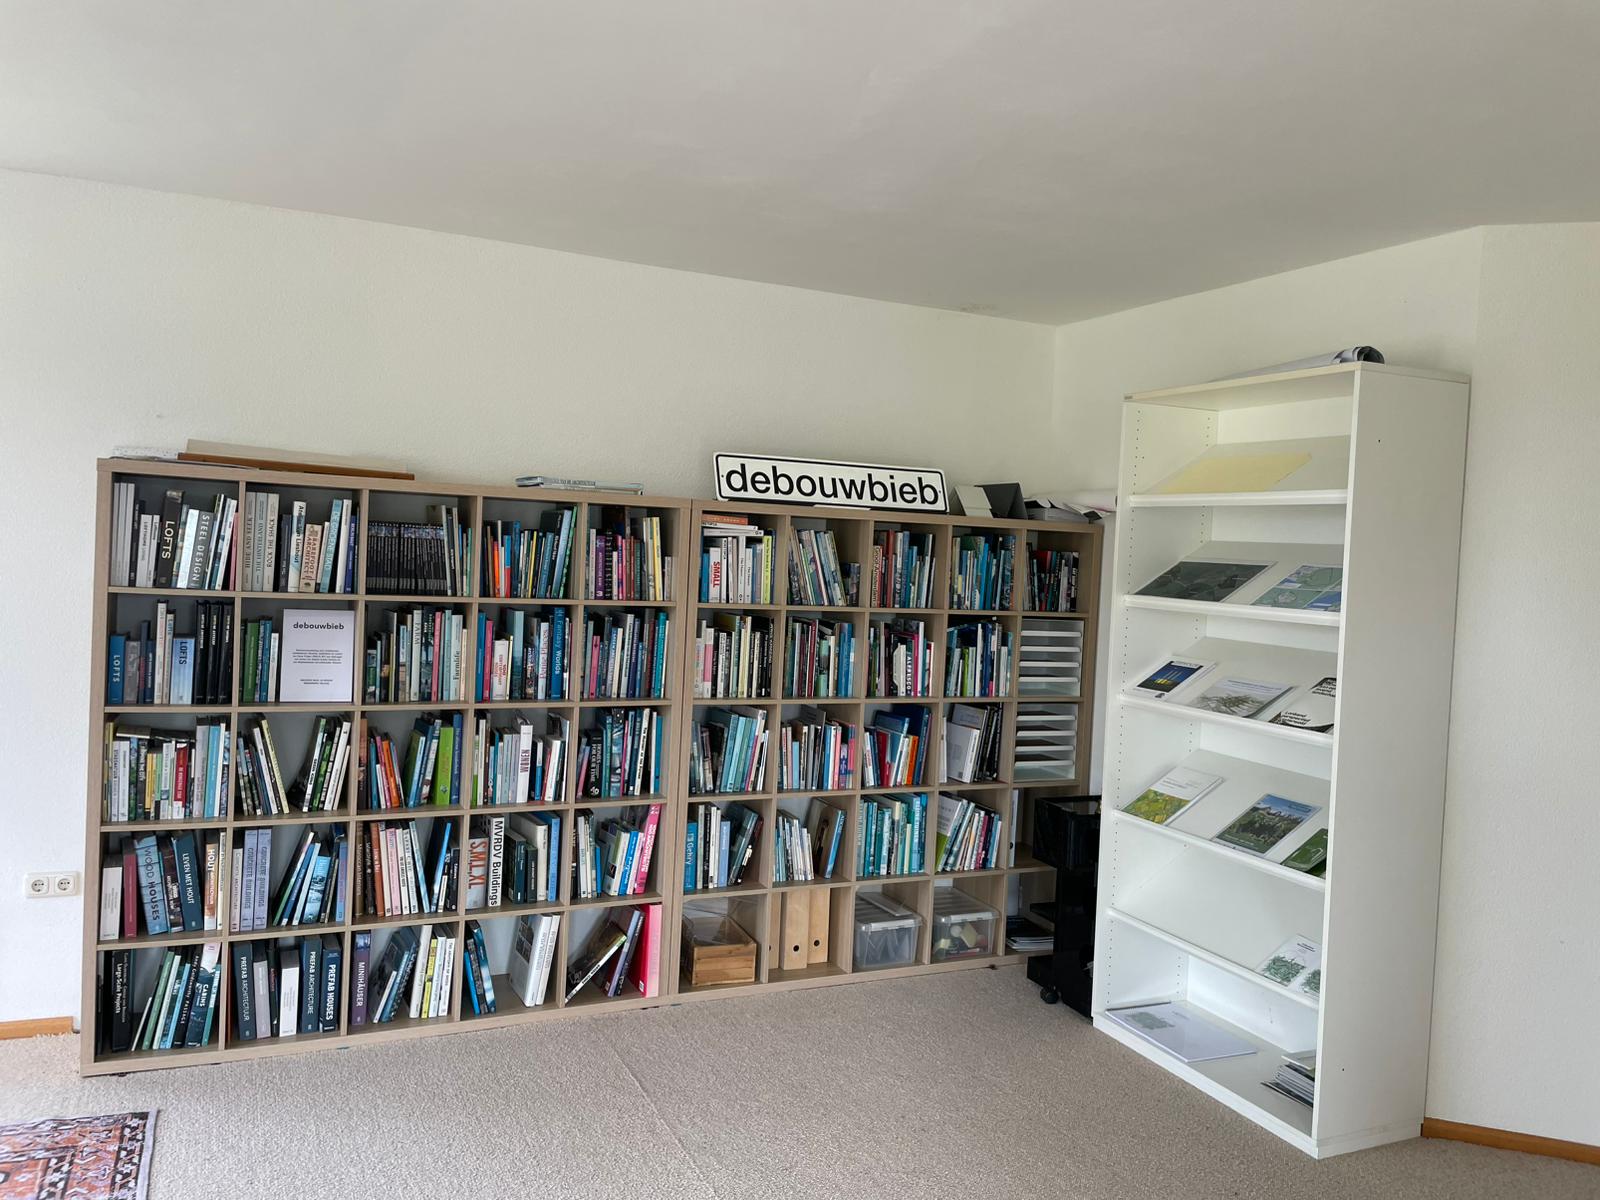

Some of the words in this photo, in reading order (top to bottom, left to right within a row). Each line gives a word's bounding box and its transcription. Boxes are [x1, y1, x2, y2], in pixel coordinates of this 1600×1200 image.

[726, 464, 939, 505] debouwbieb
[161, 520, 175, 559] LOFTS
[199, 515, 210, 540] STEEL
[192, 545, 205, 581] DESIGN
[294, 538, 303, 563] Lieshout
[712, 561, 721, 588] SMALL
[293, 621, 345, 630] debouwbieb
[555, 620, 564, 648] Fantasy
[179, 641, 188, 665] LOFTS
[493, 820, 503, 858] MVRDV
[686, 842, 694, 865] Gehry
[145, 848, 156, 879] WOOD
[182, 852, 191, 872] LEVEN
[207, 848, 215, 872] HOUT
[246, 847, 254, 878] CONCRETE
[260, 846, 268, 876] CONCRETE
[467, 840, 489, 890] S,M,L,XL
[184, 873, 192, 886] MET
[244, 879, 252, 909] BUILDINGS
[257, 877, 266, 908] BUILDINGS
[489, 862, 502, 906] Buildings
[148, 881, 160, 921] HOUSES
[187, 887, 195, 904] HOUT
[192, 955, 200, 967] Andy
[240, 957, 249, 979] PREFAB
[115, 963, 123, 992] Large-Scale
[186, 968, 197, 998] Goldsworthy
[327, 964, 336, 992] PREFAB
[356, 962, 366, 1007] MINIHÄUSER
[199, 984, 209, 1007] CABINS
[242, 980, 250, 1021] ARCHITECTUUR
[307, 974, 315, 1014] ARCHITECTURE
[326, 992, 335, 1021] HOUSES
[180, 1000, 190, 1024] PASSAGE
